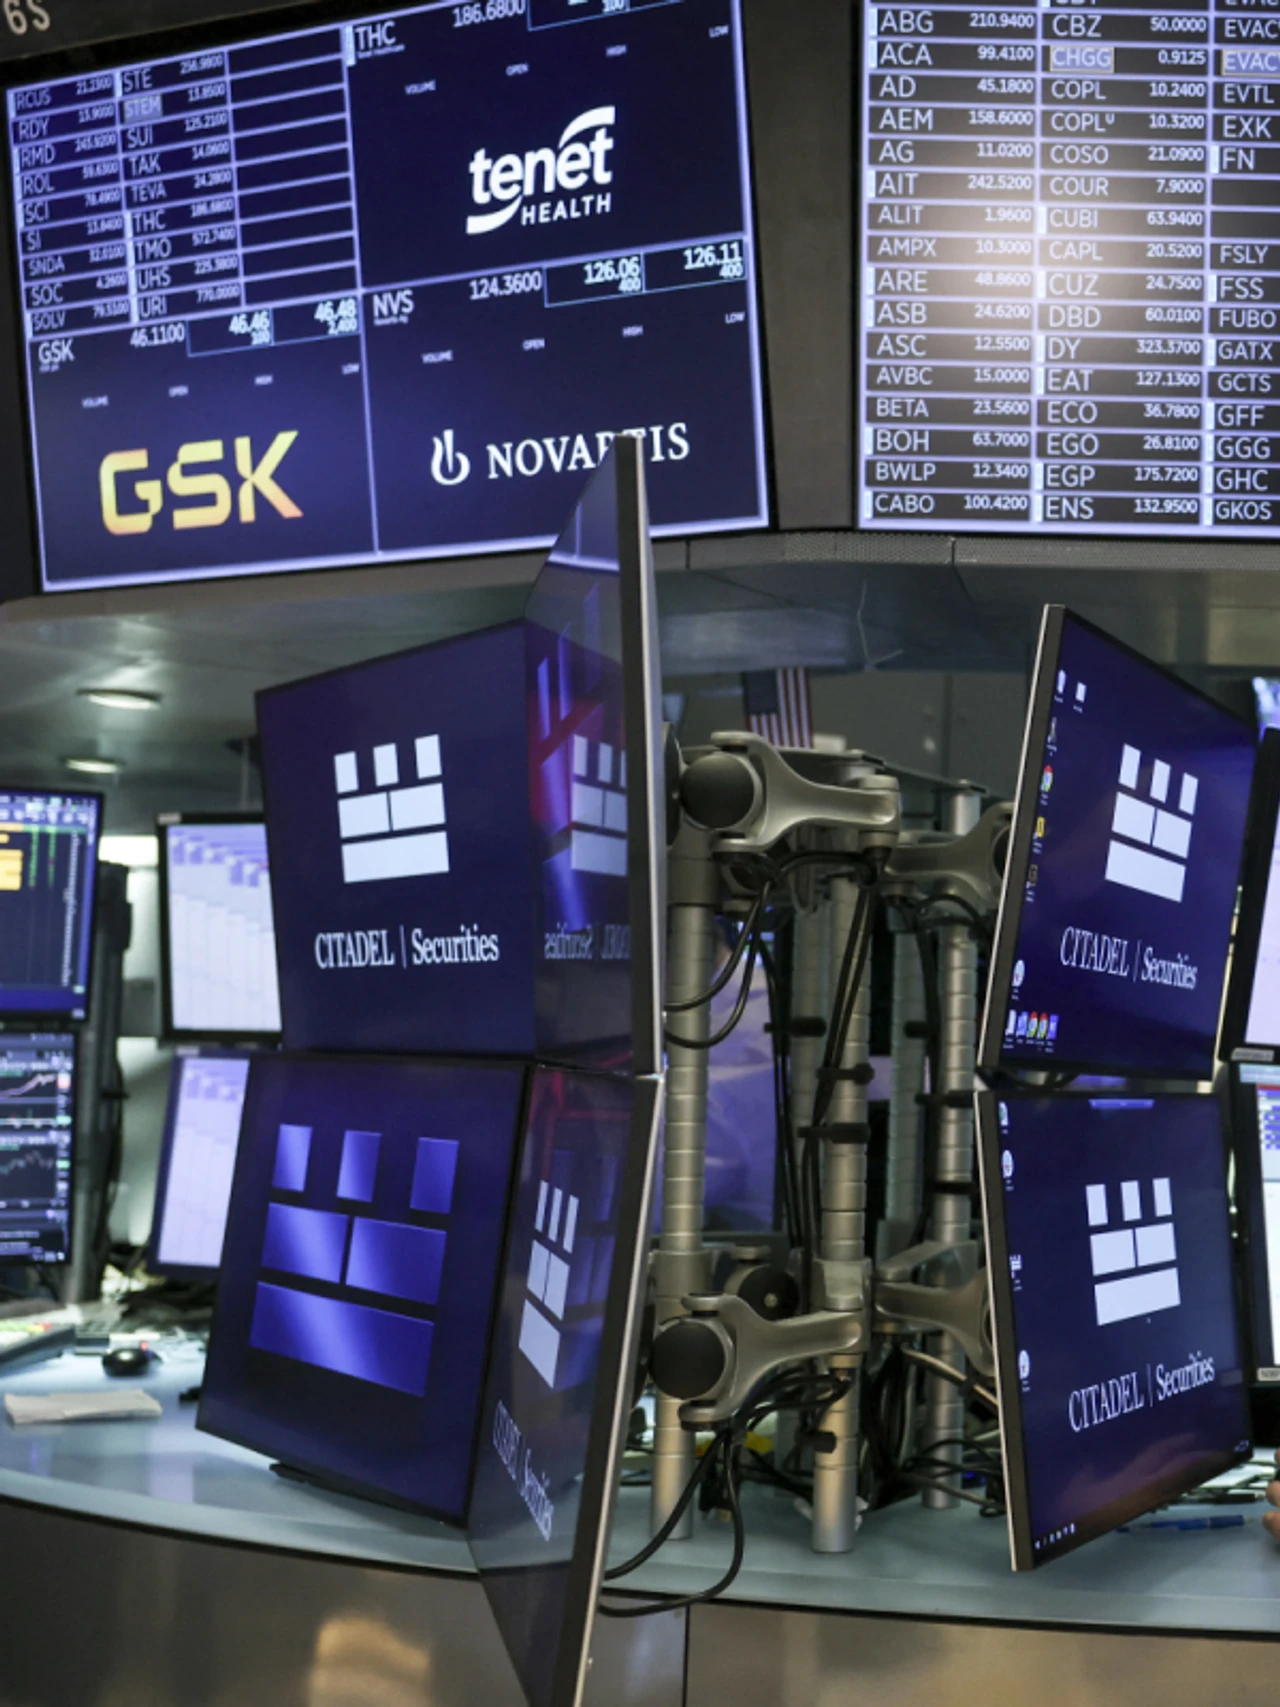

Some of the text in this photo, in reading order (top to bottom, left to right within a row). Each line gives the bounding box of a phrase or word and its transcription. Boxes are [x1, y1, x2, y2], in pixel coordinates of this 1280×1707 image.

[355, 20, 397, 50] THC
[1052, 13, 1207, 37] CBZ 50.0000
[880, 42, 1034, 66] ACA 99.4100
[124, 69, 153, 93] STE
[1051, 80, 1206, 100] COPL 10.2400
[125, 97, 162, 118] STEM
[19, 118, 50, 140] RDY
[127, 127, 153, 149] SUI
[1223, 115, 1270, 139] EXK
[21, 146, 56, 168] RMD
[880, 139, 914, 163] AG
[129, 154, 161, 177] TAK
[468, 127, 615, 205] tenet
[23, 172, 54, 195] ROL
[131, 181, 167, 203] TEVA
[1049, 176, 1109, 196] COUR
[25, 201, 50, 223] SCI
[134, 210, 166, 232] THC
[521, 193, 612, 226] HEALTH
[136, 238, 172, 261] TMO
[1047, 241, 1103, 261] CAPL
[137, 266, 171, 290] UHS
[373, 242, 743, 318] NVS 124.3600 126.06 126.11
[1217, 276, 1264, 300] FSS
[31, 283, 64, 306] SOC
[139, 295, 167, 318] URI
[725, 311, 745, 325] LOW
[38, 339, 75, 364] GSK
[130, 322, 185, 348] 46.1100
[1046, 336, 1199, 360] DY 323.3700
[877, 366, 1030, 386] AVBC 15.0000
[1217, 372, 1271, 392] GCTS
[1047, 400, 1200, 424] ECO 36.7800
[486, 422, 691, 480] NOVAIS
[1215, 432, 1270, 458] GGG
[100, 430, 304, 536] GSK
[876, 461, 1029, 482] BWLP 12.3400
[1046, 496, 1198, 520] ENS 132.9500
[315, 923, 499, 969] CITADEL Securities
[1060, 926, 1199, 990] CITADEL Securities
[1068, 1350, 1215, 1433] CITADEL Securities
